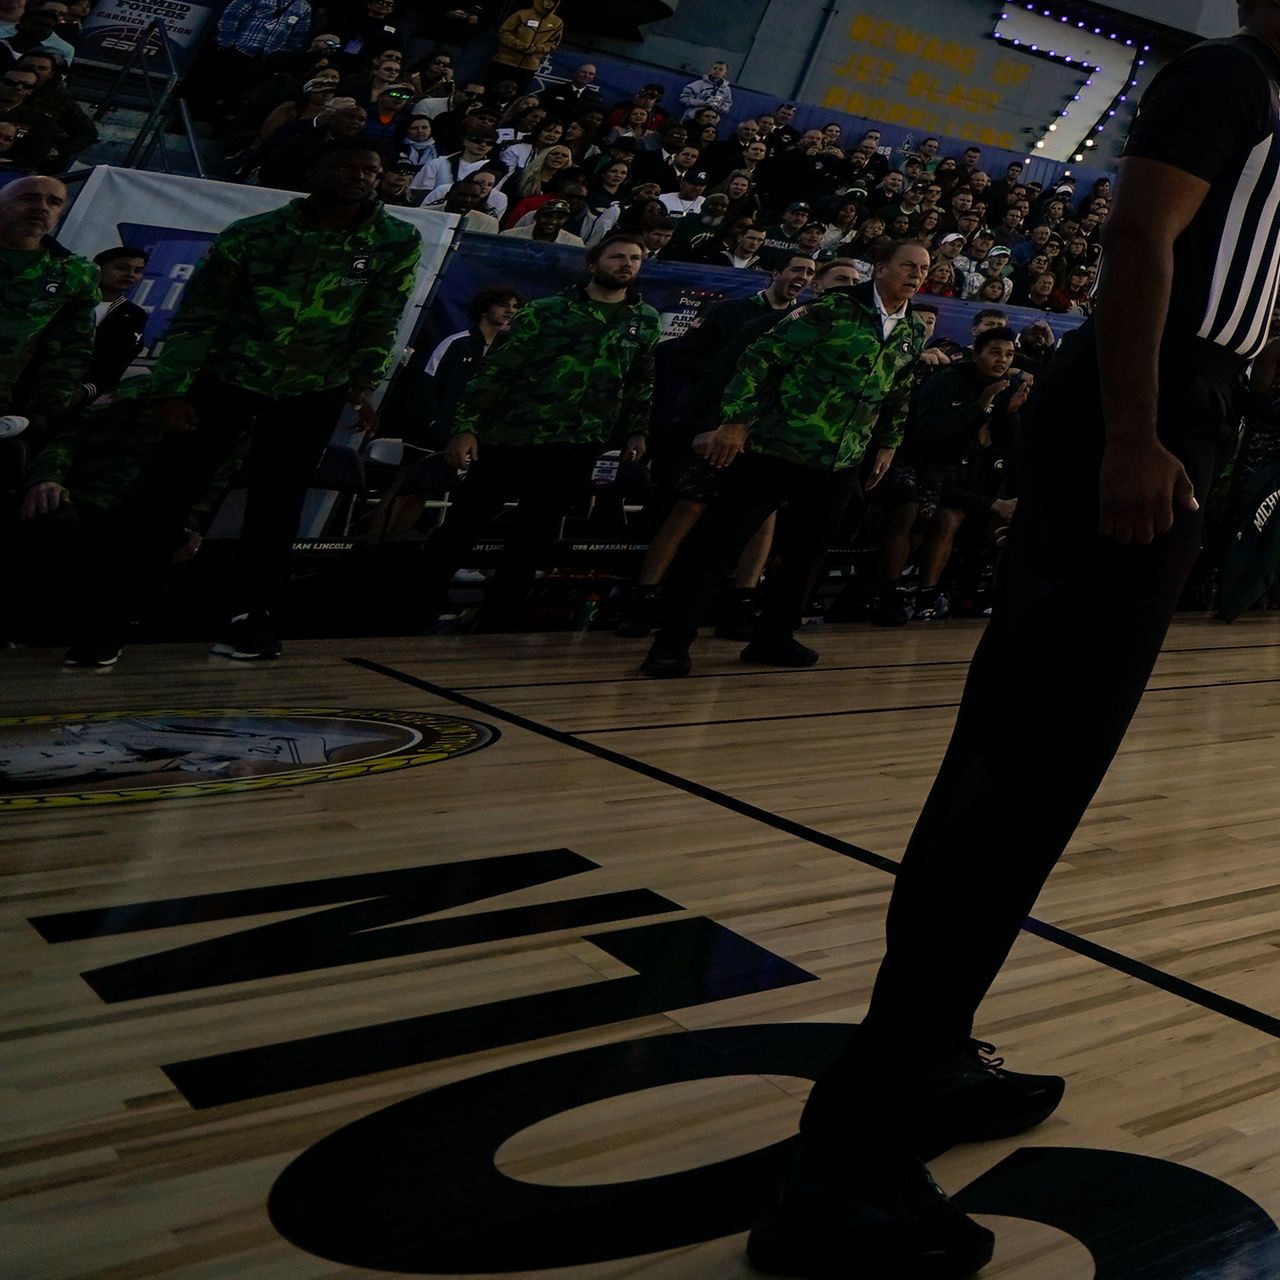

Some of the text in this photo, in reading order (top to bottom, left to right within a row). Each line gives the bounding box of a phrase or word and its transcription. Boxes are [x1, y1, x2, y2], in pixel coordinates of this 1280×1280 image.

[116, 0, 187, 20] FORCES
[849, 15, 977, 75] BEWARE
[834, 52, 1001, 115] JET BLAST
[993, 0, 1139, 163] 7
[679, 296, 702, 308] Pera
[313, 542, 354, 551] LINCOLN
